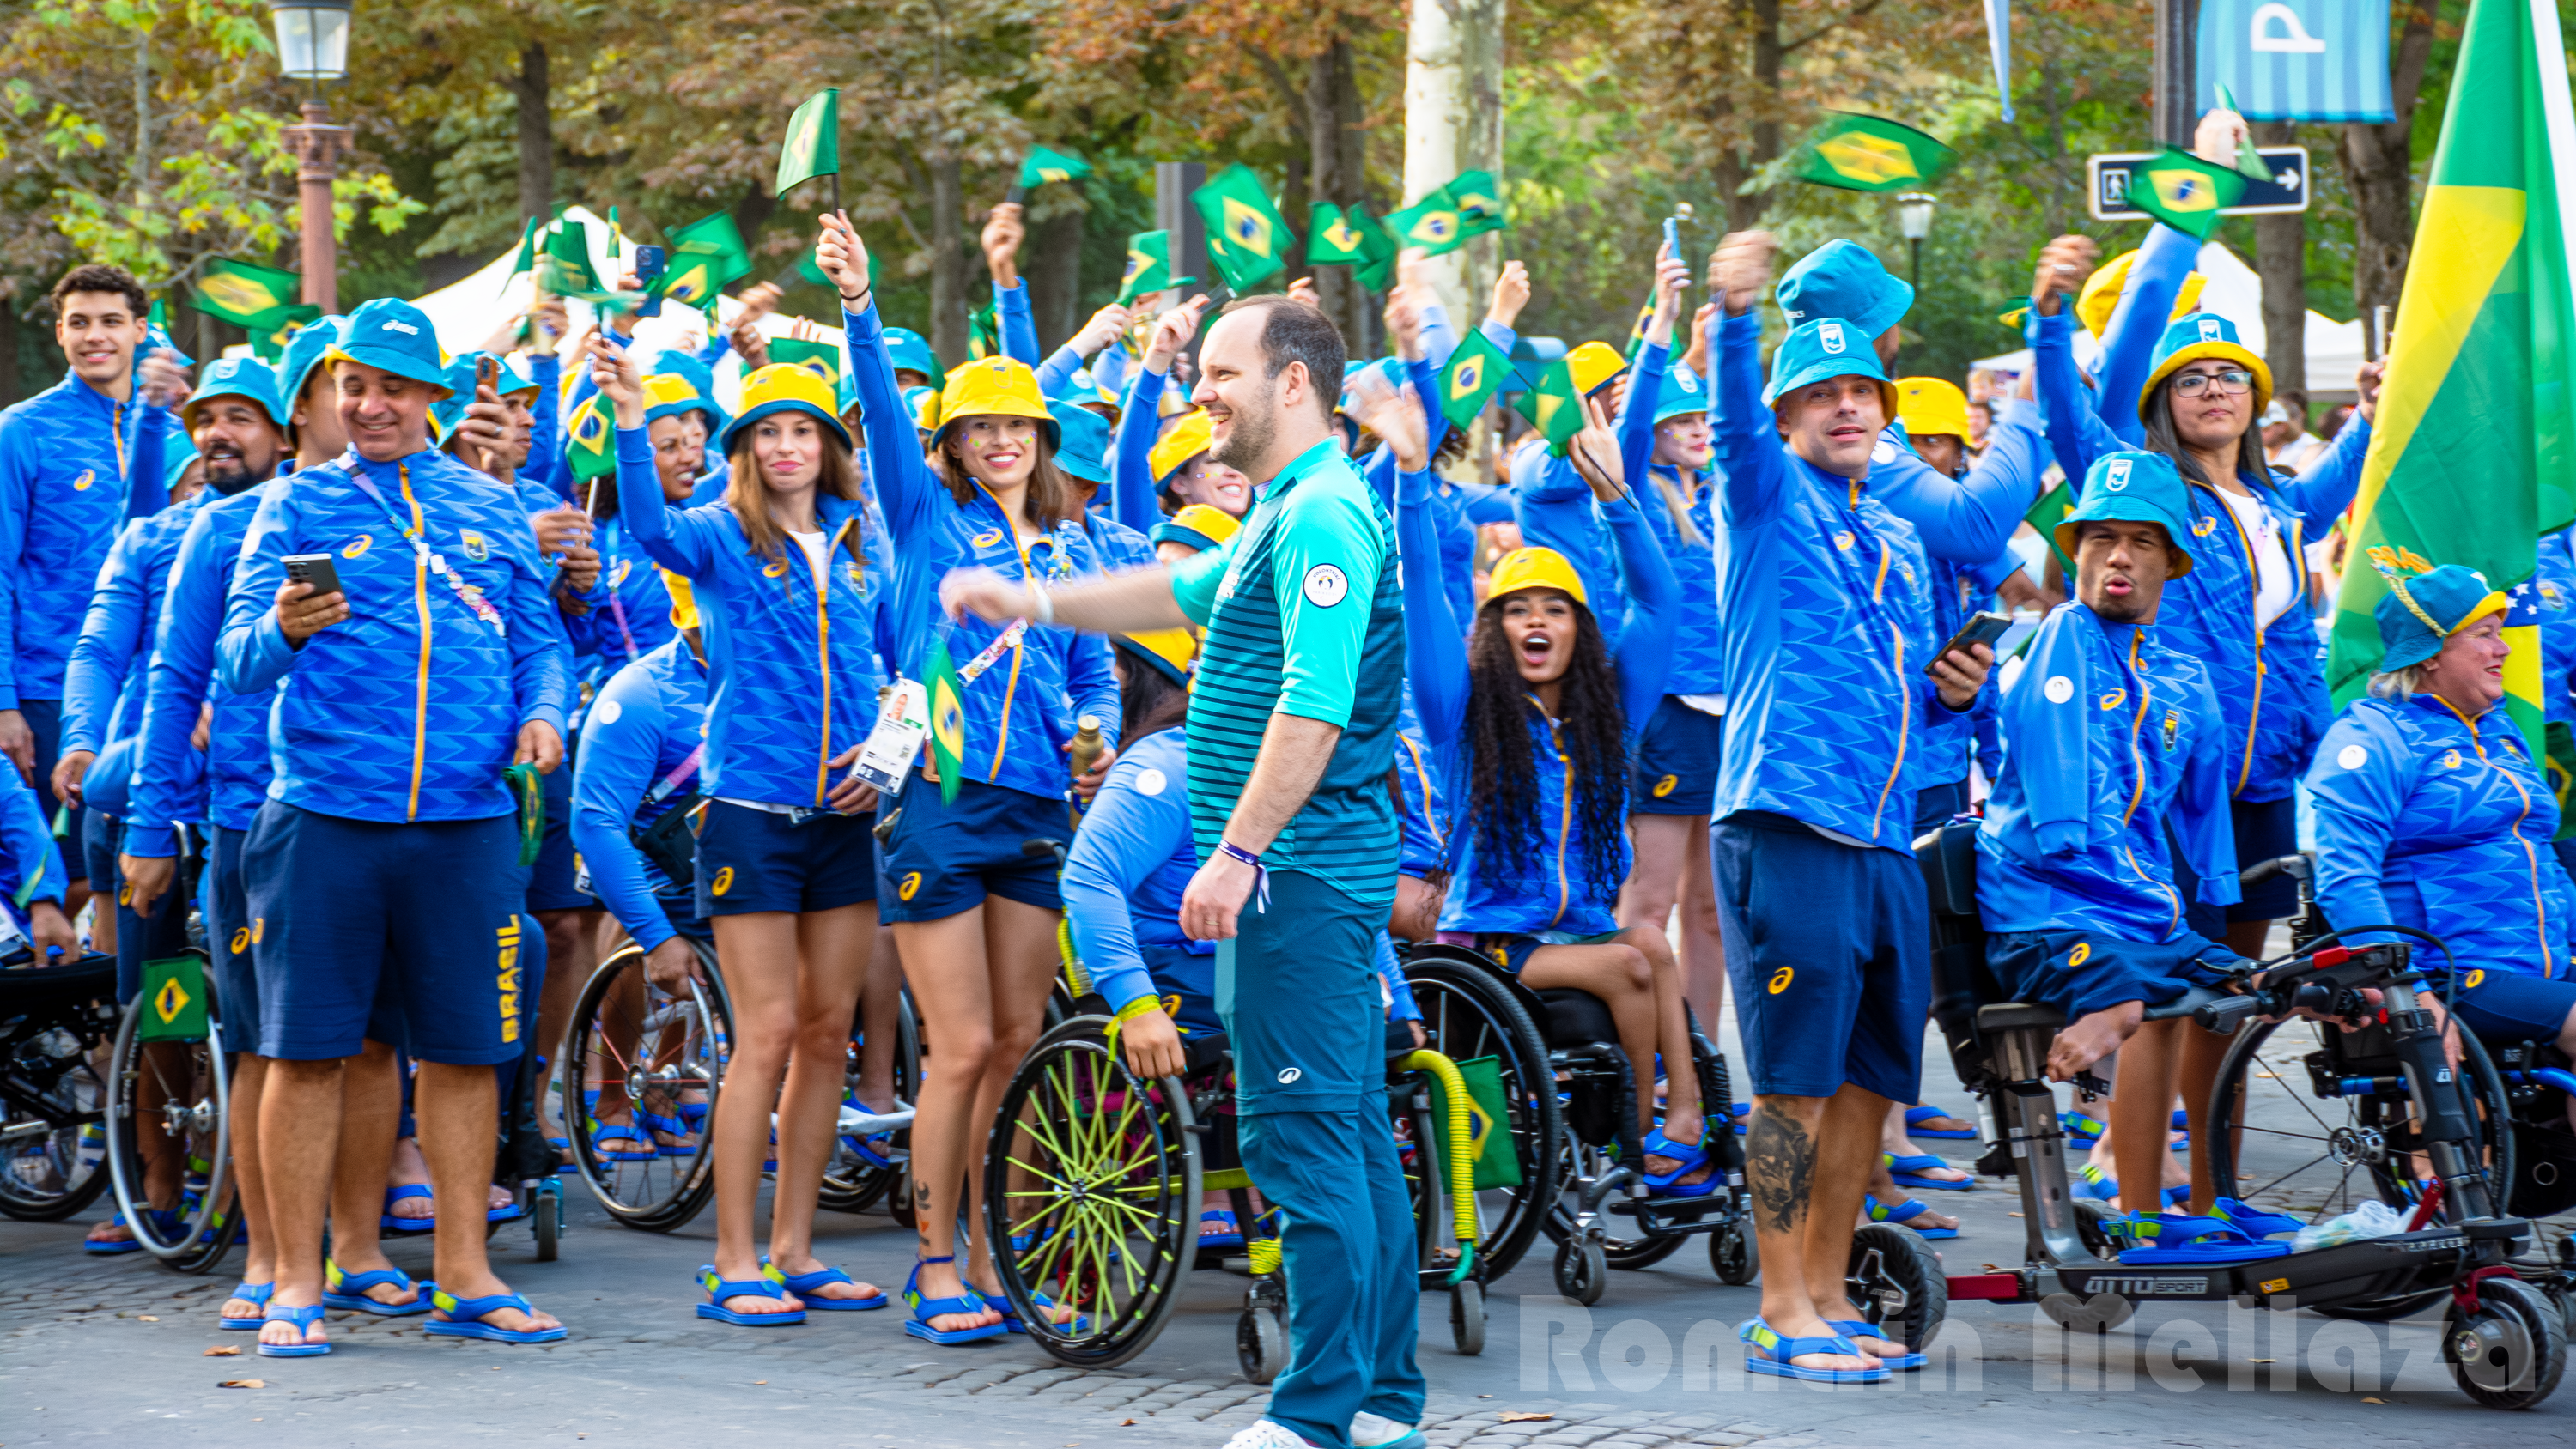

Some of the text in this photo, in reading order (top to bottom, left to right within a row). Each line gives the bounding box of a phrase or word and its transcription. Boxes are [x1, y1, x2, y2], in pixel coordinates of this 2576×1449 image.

[2251, 2, 2326, 53] P
[495, 913, 523, 1044] BRASIL
[2156, 1279, 2208, 1294] SPORT
